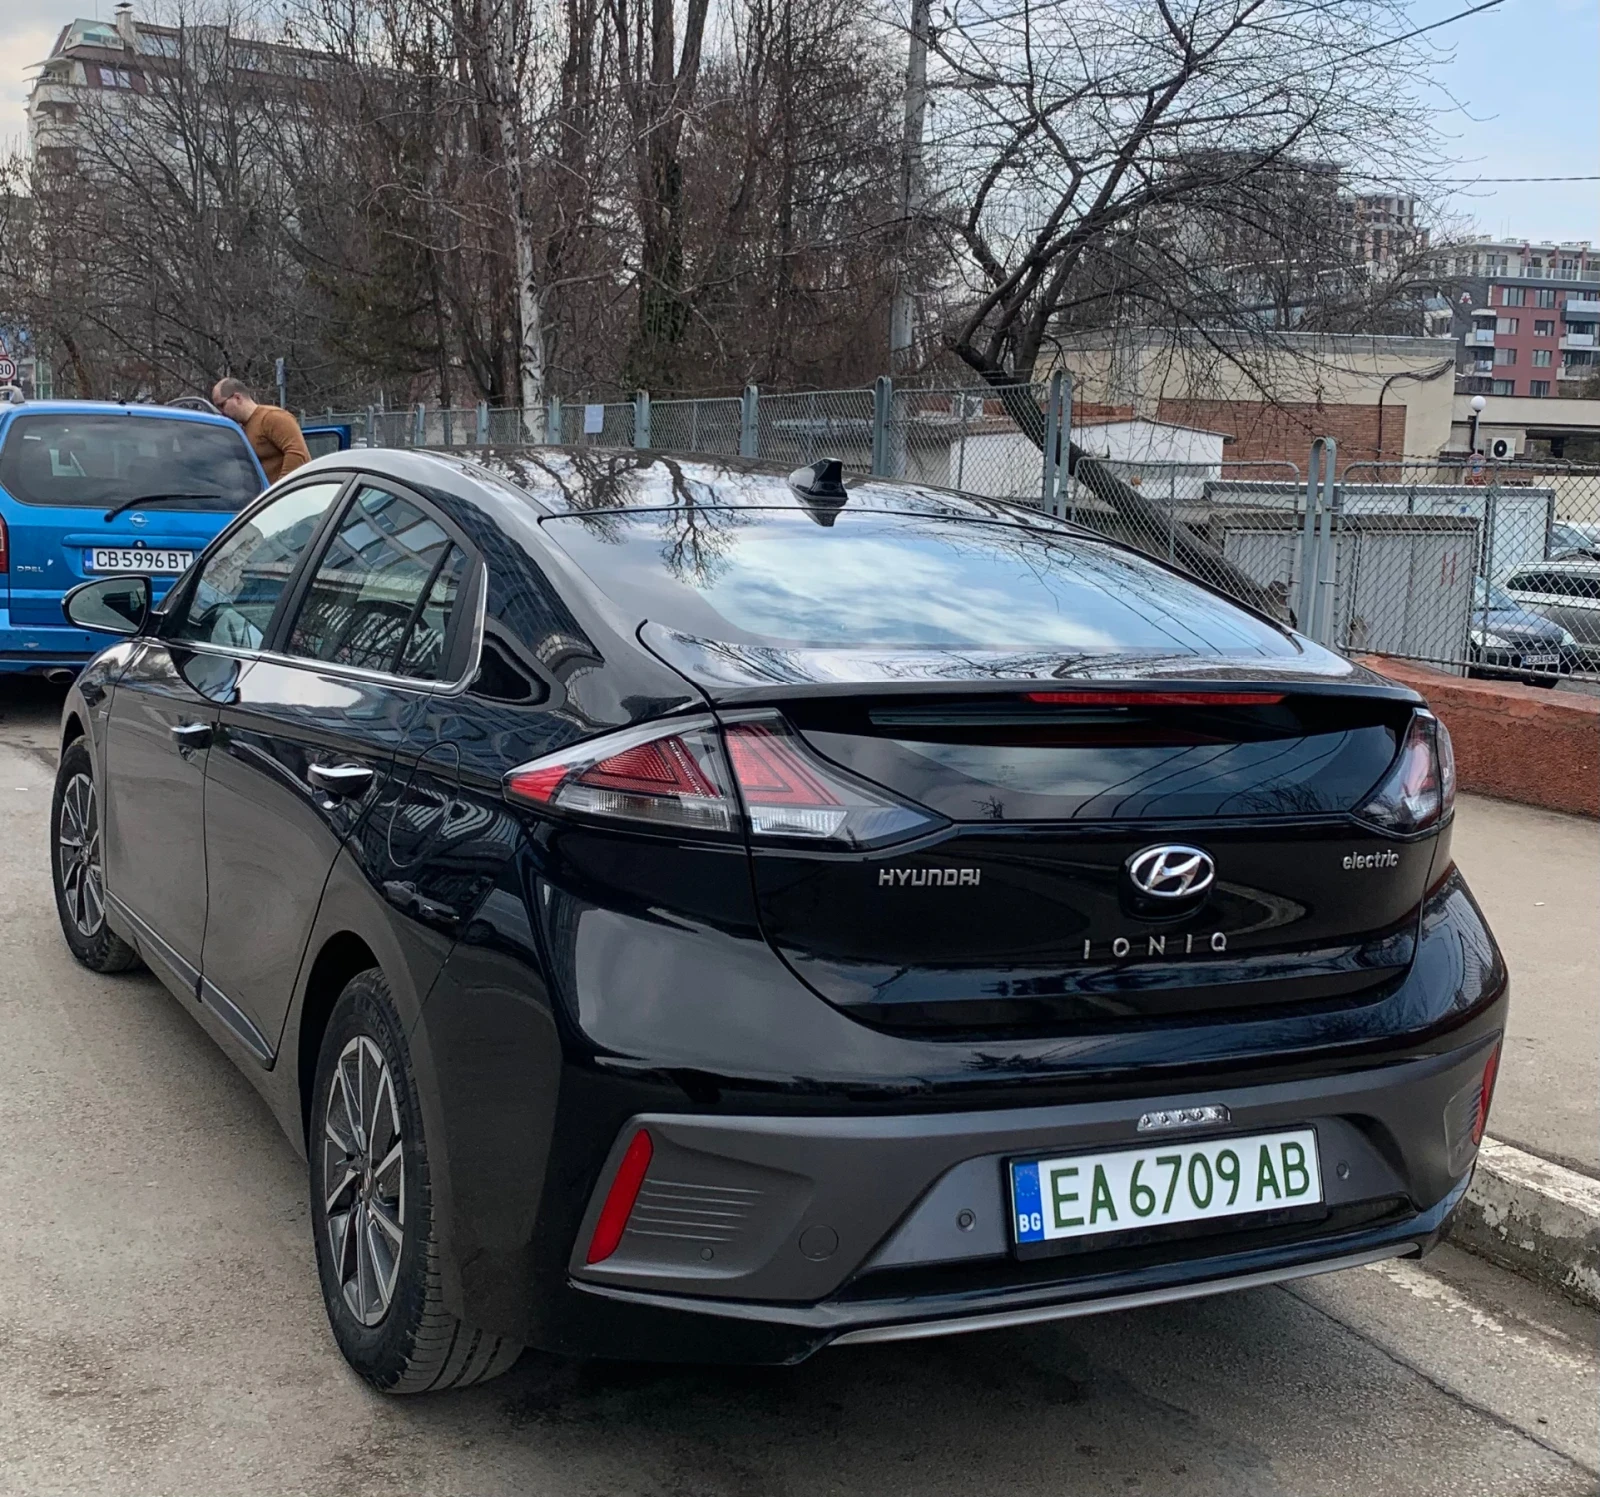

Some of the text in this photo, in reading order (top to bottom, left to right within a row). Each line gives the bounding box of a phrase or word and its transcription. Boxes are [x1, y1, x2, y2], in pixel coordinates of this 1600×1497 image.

[16, 565, 44, 573] OPEL
[96, 551, 119, 567] CB
[122, 551, 164, 569] 5996
[168, 553, 191, 569] BT
[1342, 849, 1399, 871] electric
[878, 867, 981, 887] HYUNDAI
[1083, 931, 1228, 960] IONIQ
[1050, 1141, 1310, 1228] EA 6709 AB
[1018, 1212, 1042, 1233] BG
